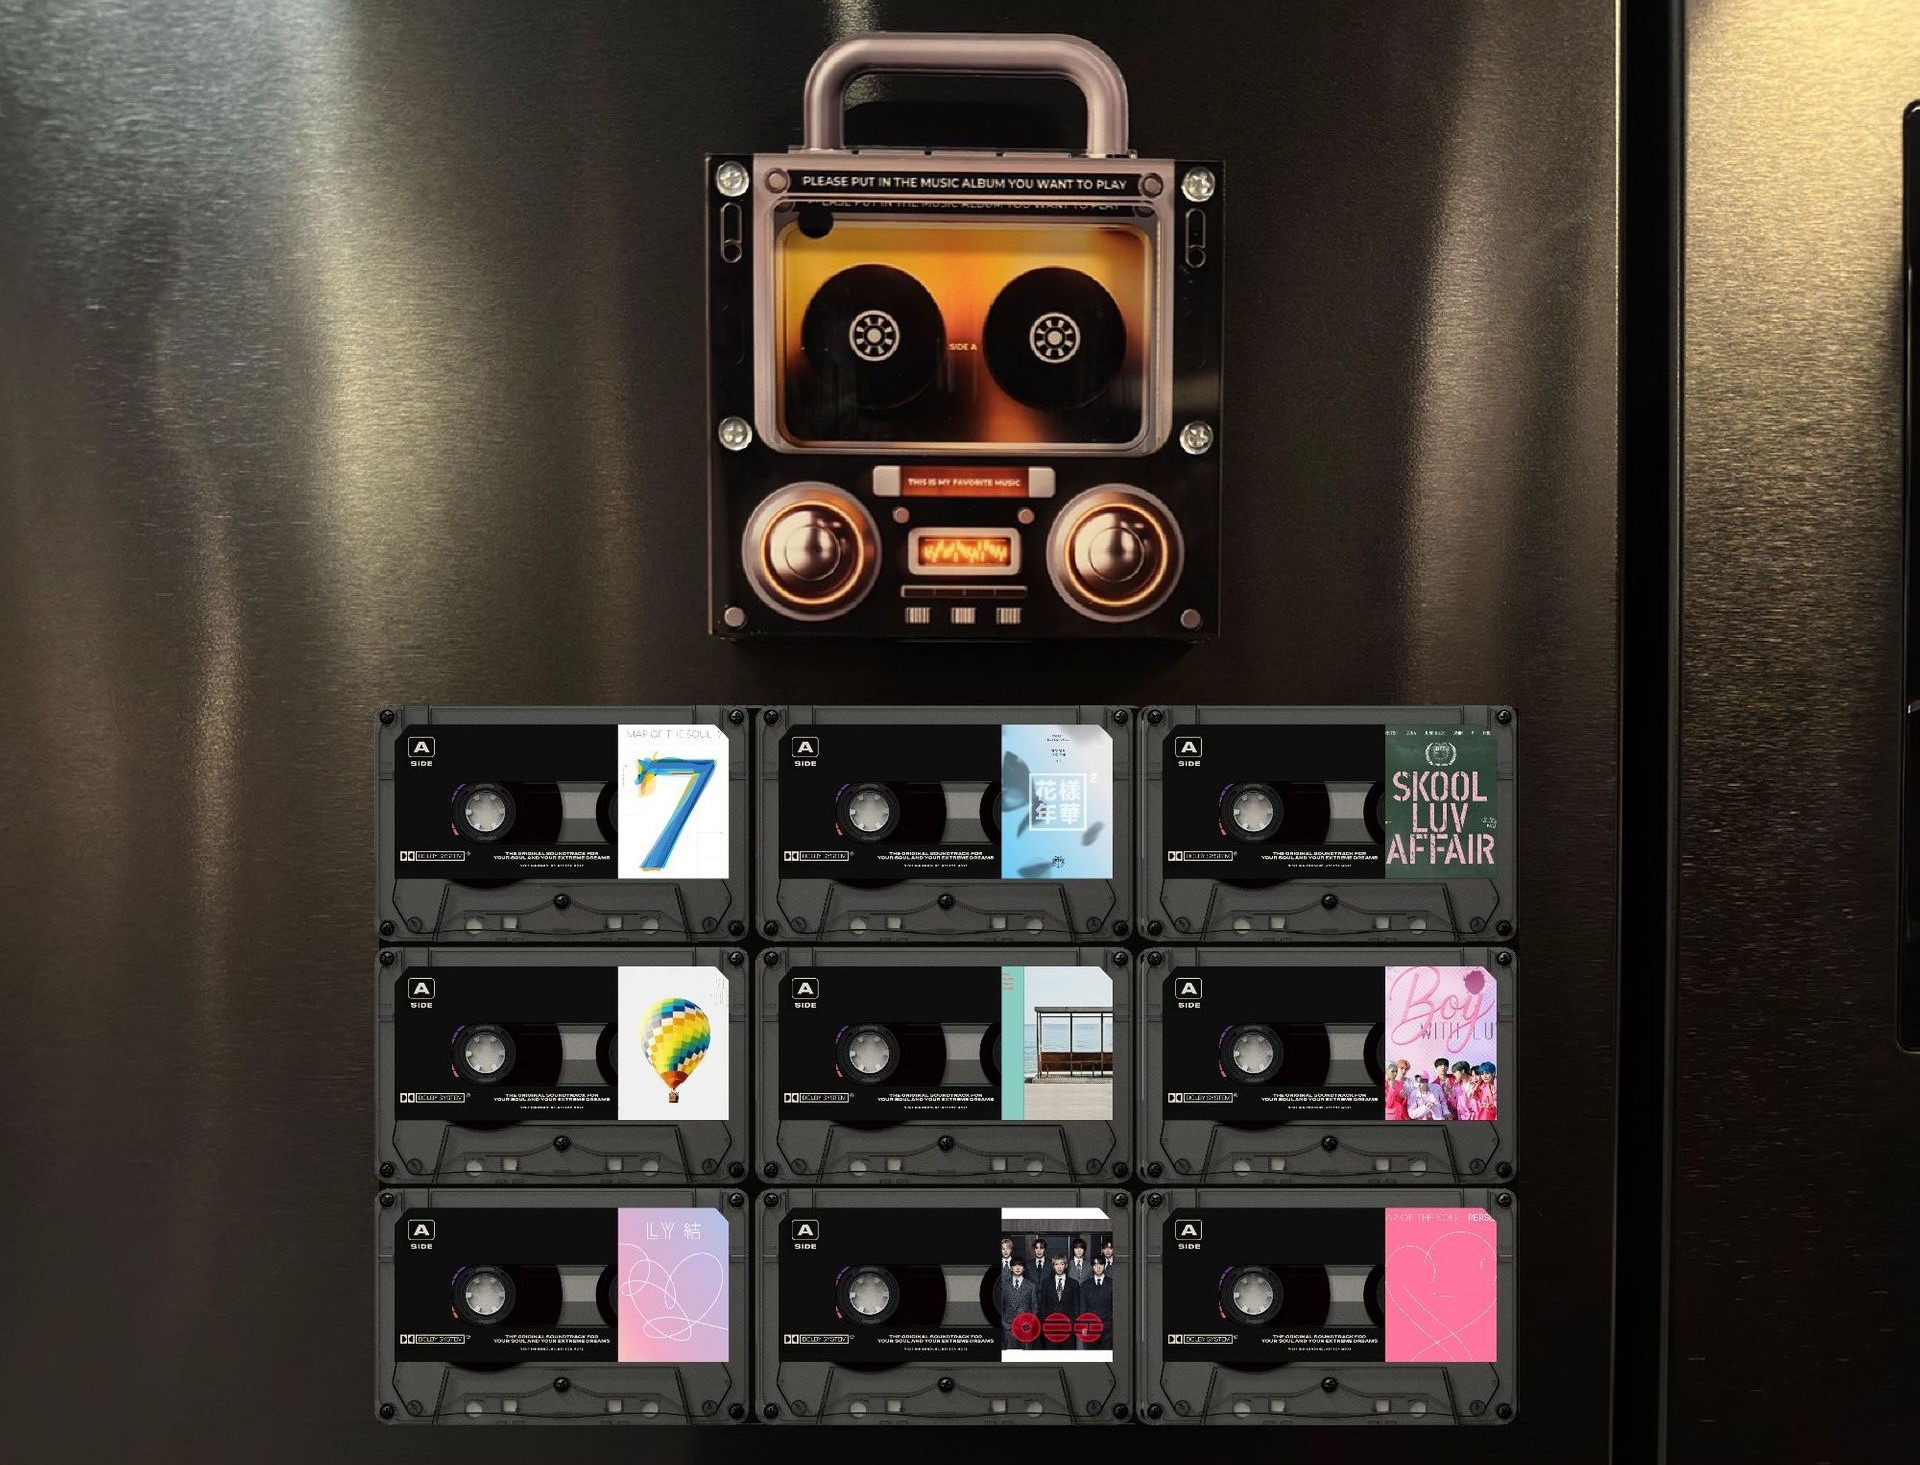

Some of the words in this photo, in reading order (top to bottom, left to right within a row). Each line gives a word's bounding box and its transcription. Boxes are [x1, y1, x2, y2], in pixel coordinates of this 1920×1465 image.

[803, 176, 849, 186] PLEASE
[851, 177, 875, 187] PUT
[878, 177, 891, 187] IN
[893, 177, 918, 188] THE
[920, 177, 960, 188] MUSIC
[961, 178, 1006, 189] ALBUM
[1007, 178, 1035, 189] YOU
[1036, 179, 1073, 189] WANT
[1075, 179, 1093, 190] TO
[1096, 179, 1127, 190] PLAY
[949, 343, 969, 351] SIDE
[970, 343, 978, 351] A
[908, 478, 927, 487] THIS
[928, 478, 937, 487] IS
[938, 478, 951, 487] MY
[952, 478, 993, 487] FAVORITE
[994, 478, 1021, 487] MUSIC
[413, 741, 430, 753] A
[797, 741, 814, 753] A
[1180, 741, 1198, 753] A
[1392, 771, 1488, 802] SKOOL
[635, 752, 717, 872] 7
[1412, 802, 1469, 833] LUV
[1386, 834, 1495, 864] AFFAIR
[413, 982, 430, 994] A
[797, 982, 814, 994] A
[1180, 982, 1198, 994] A
[1389, 966, 1495, 1053] Boy
[1420, 1021, 1459, 1040] WITH
[413, 1224, 430, 1236] A
[797, 1224, 814, 1236] A
[1180, 1224, 1198, 1236] A
